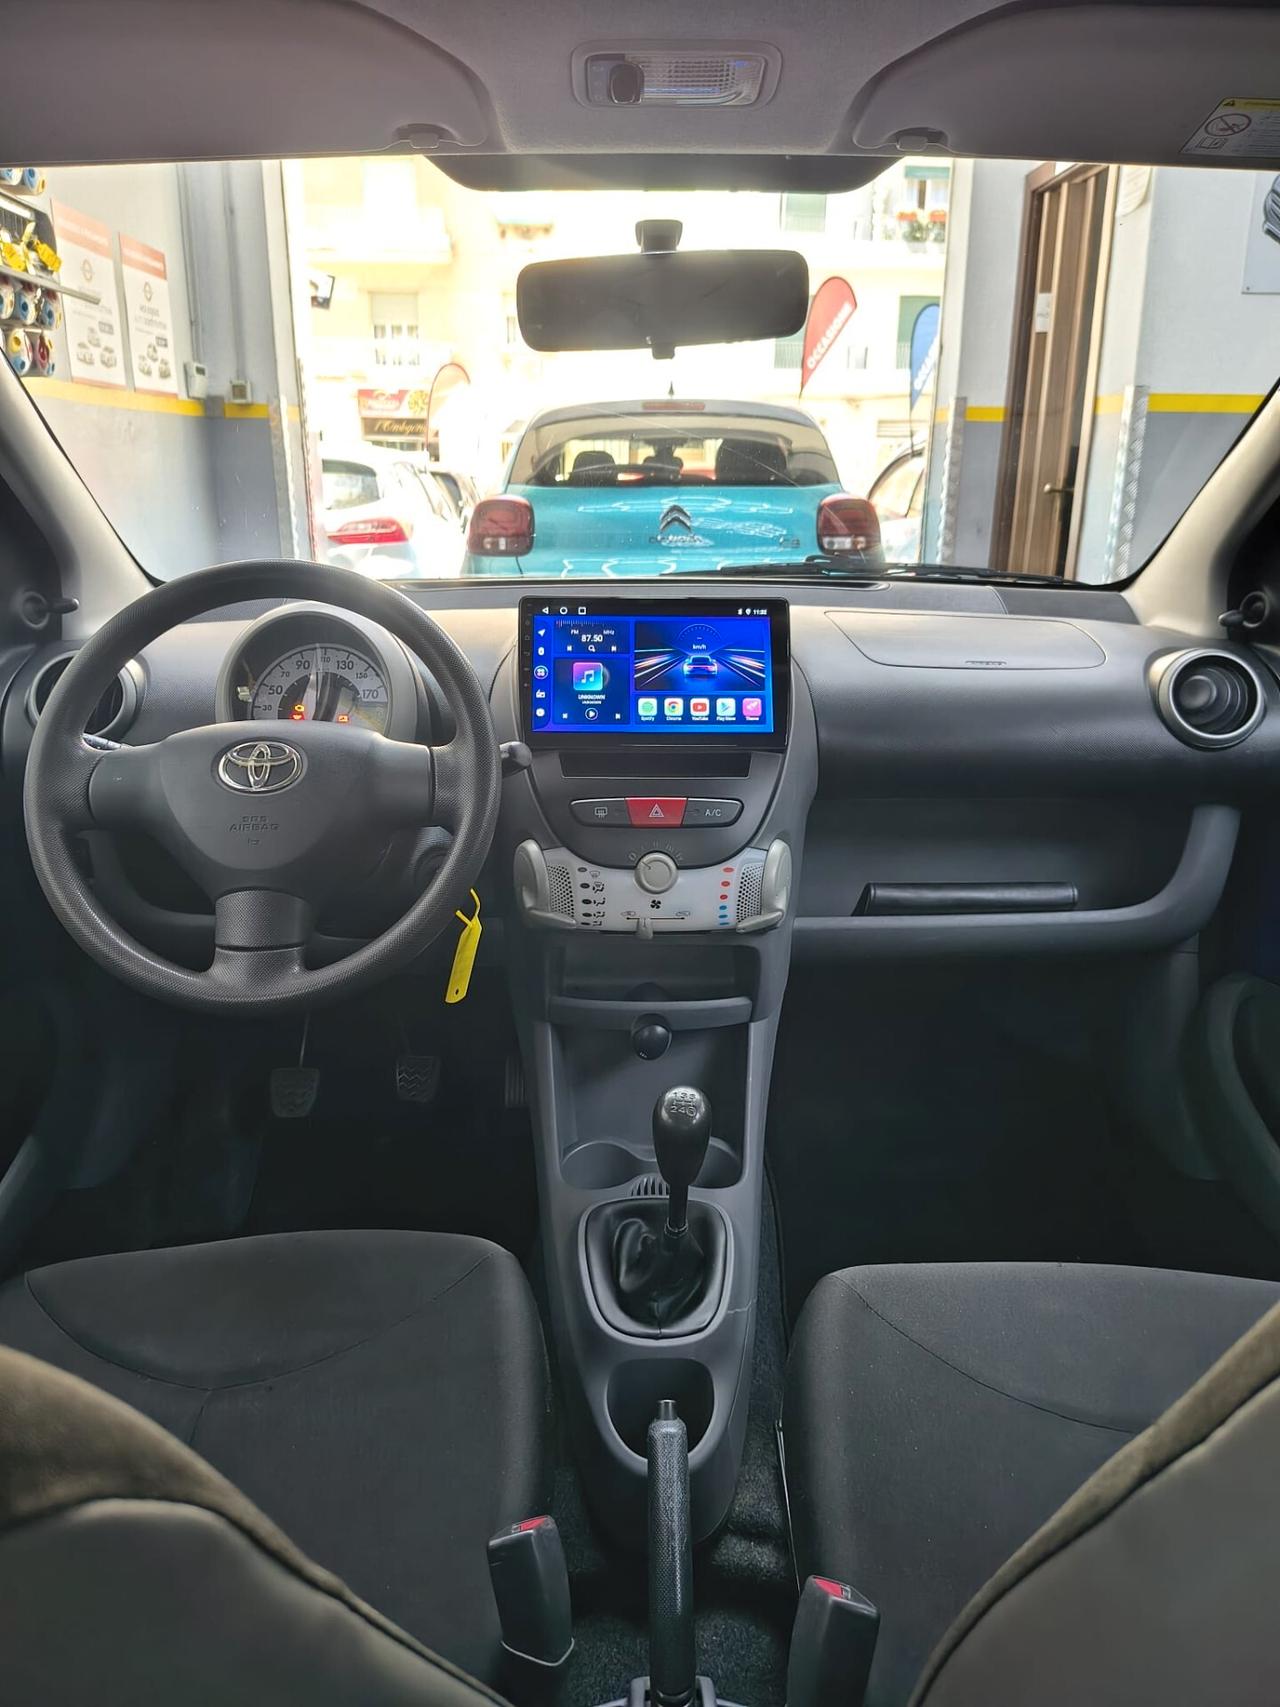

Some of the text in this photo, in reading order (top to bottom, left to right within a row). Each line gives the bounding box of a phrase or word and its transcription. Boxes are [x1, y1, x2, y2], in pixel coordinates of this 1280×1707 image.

[581, 634, 603, 642] 87.50
[295, 660, 310, 670] 90
[336, 660, 354, 670] 130
[268, 685, 283, 695] 50
[361, 689, 379, 699] 170
[704, 808, 722, 817] A/C
[670, 1105, 678, 1113] 2
